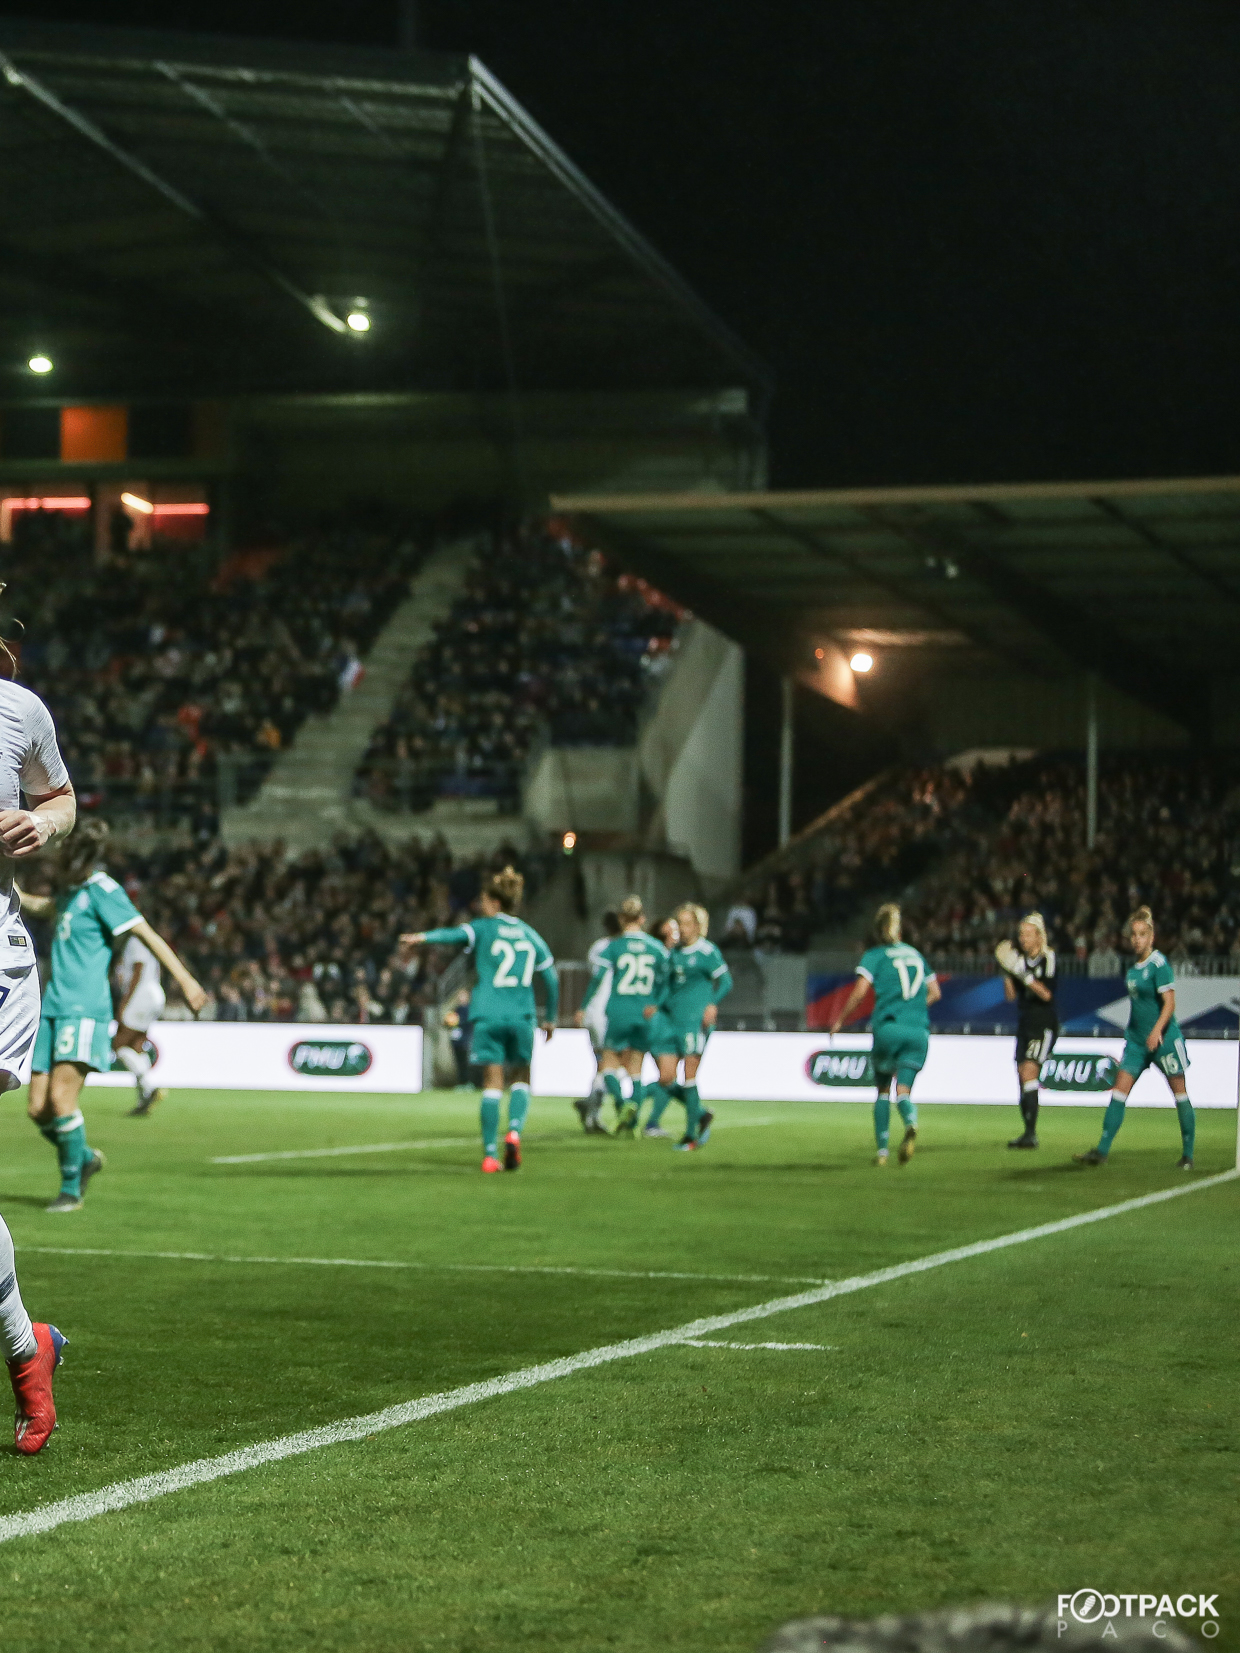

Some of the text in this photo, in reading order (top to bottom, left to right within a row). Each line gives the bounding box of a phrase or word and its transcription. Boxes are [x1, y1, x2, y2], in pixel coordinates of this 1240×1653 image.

[491, 938, 536, 988] 27
[617, 953, 656, 995] 25
[892, 957, 925, 1000] 17
[293, 1045, 347, 1069] PMU
[813, 1055, 867, 1079] PMU
[1039, 1059, 1092, 1083] PMU
